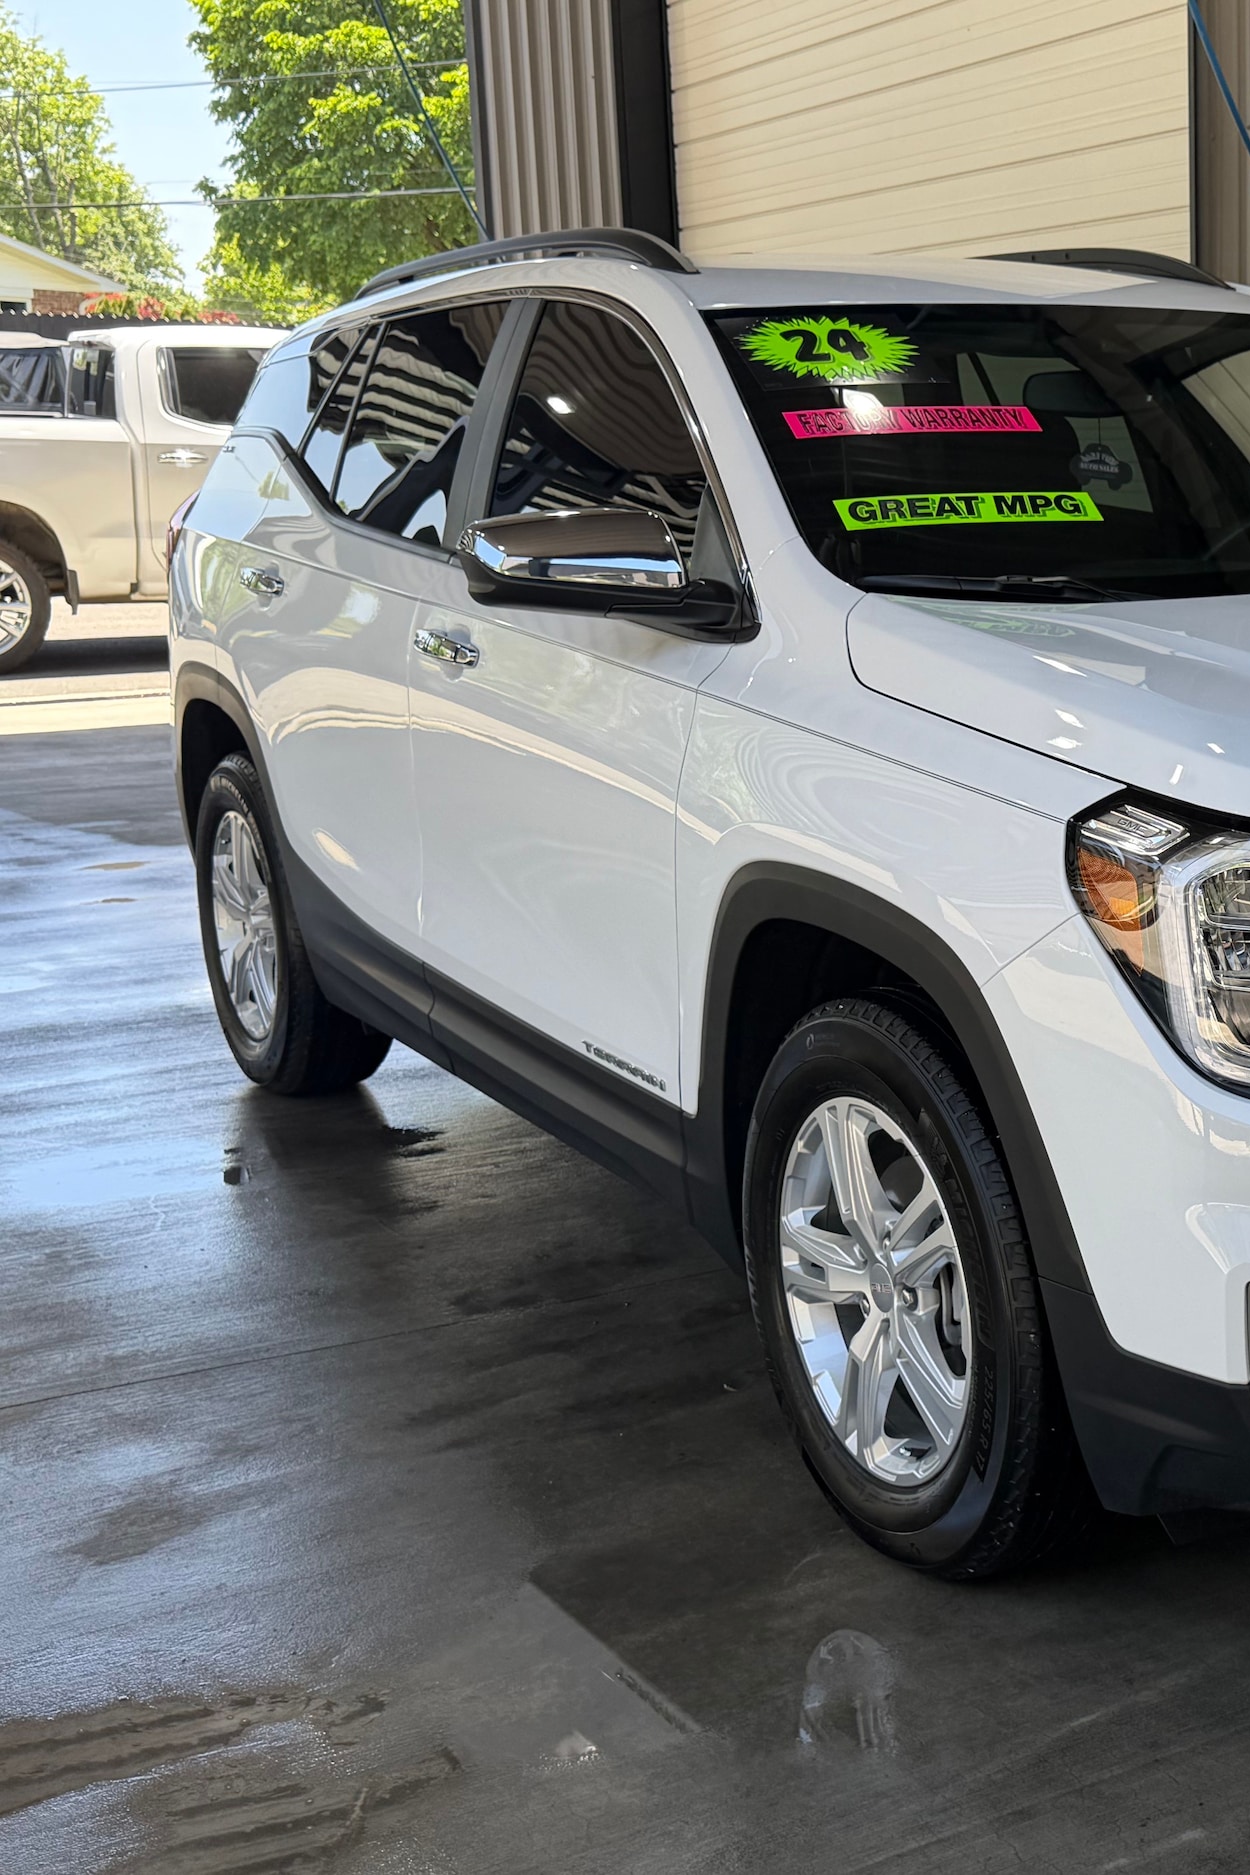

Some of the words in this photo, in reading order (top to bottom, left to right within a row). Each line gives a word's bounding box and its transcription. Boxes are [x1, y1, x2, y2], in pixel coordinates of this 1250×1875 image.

[779, 328, 868, 363] 24
[797, 409, 898, 435] FACTORY
[901, 407, 1025, 430] WARRANTY
[847, 496, 982, 523] GREAT
[994, 494, 1085, 516] MPG
[1117, 818, 1149, 836] GMC
